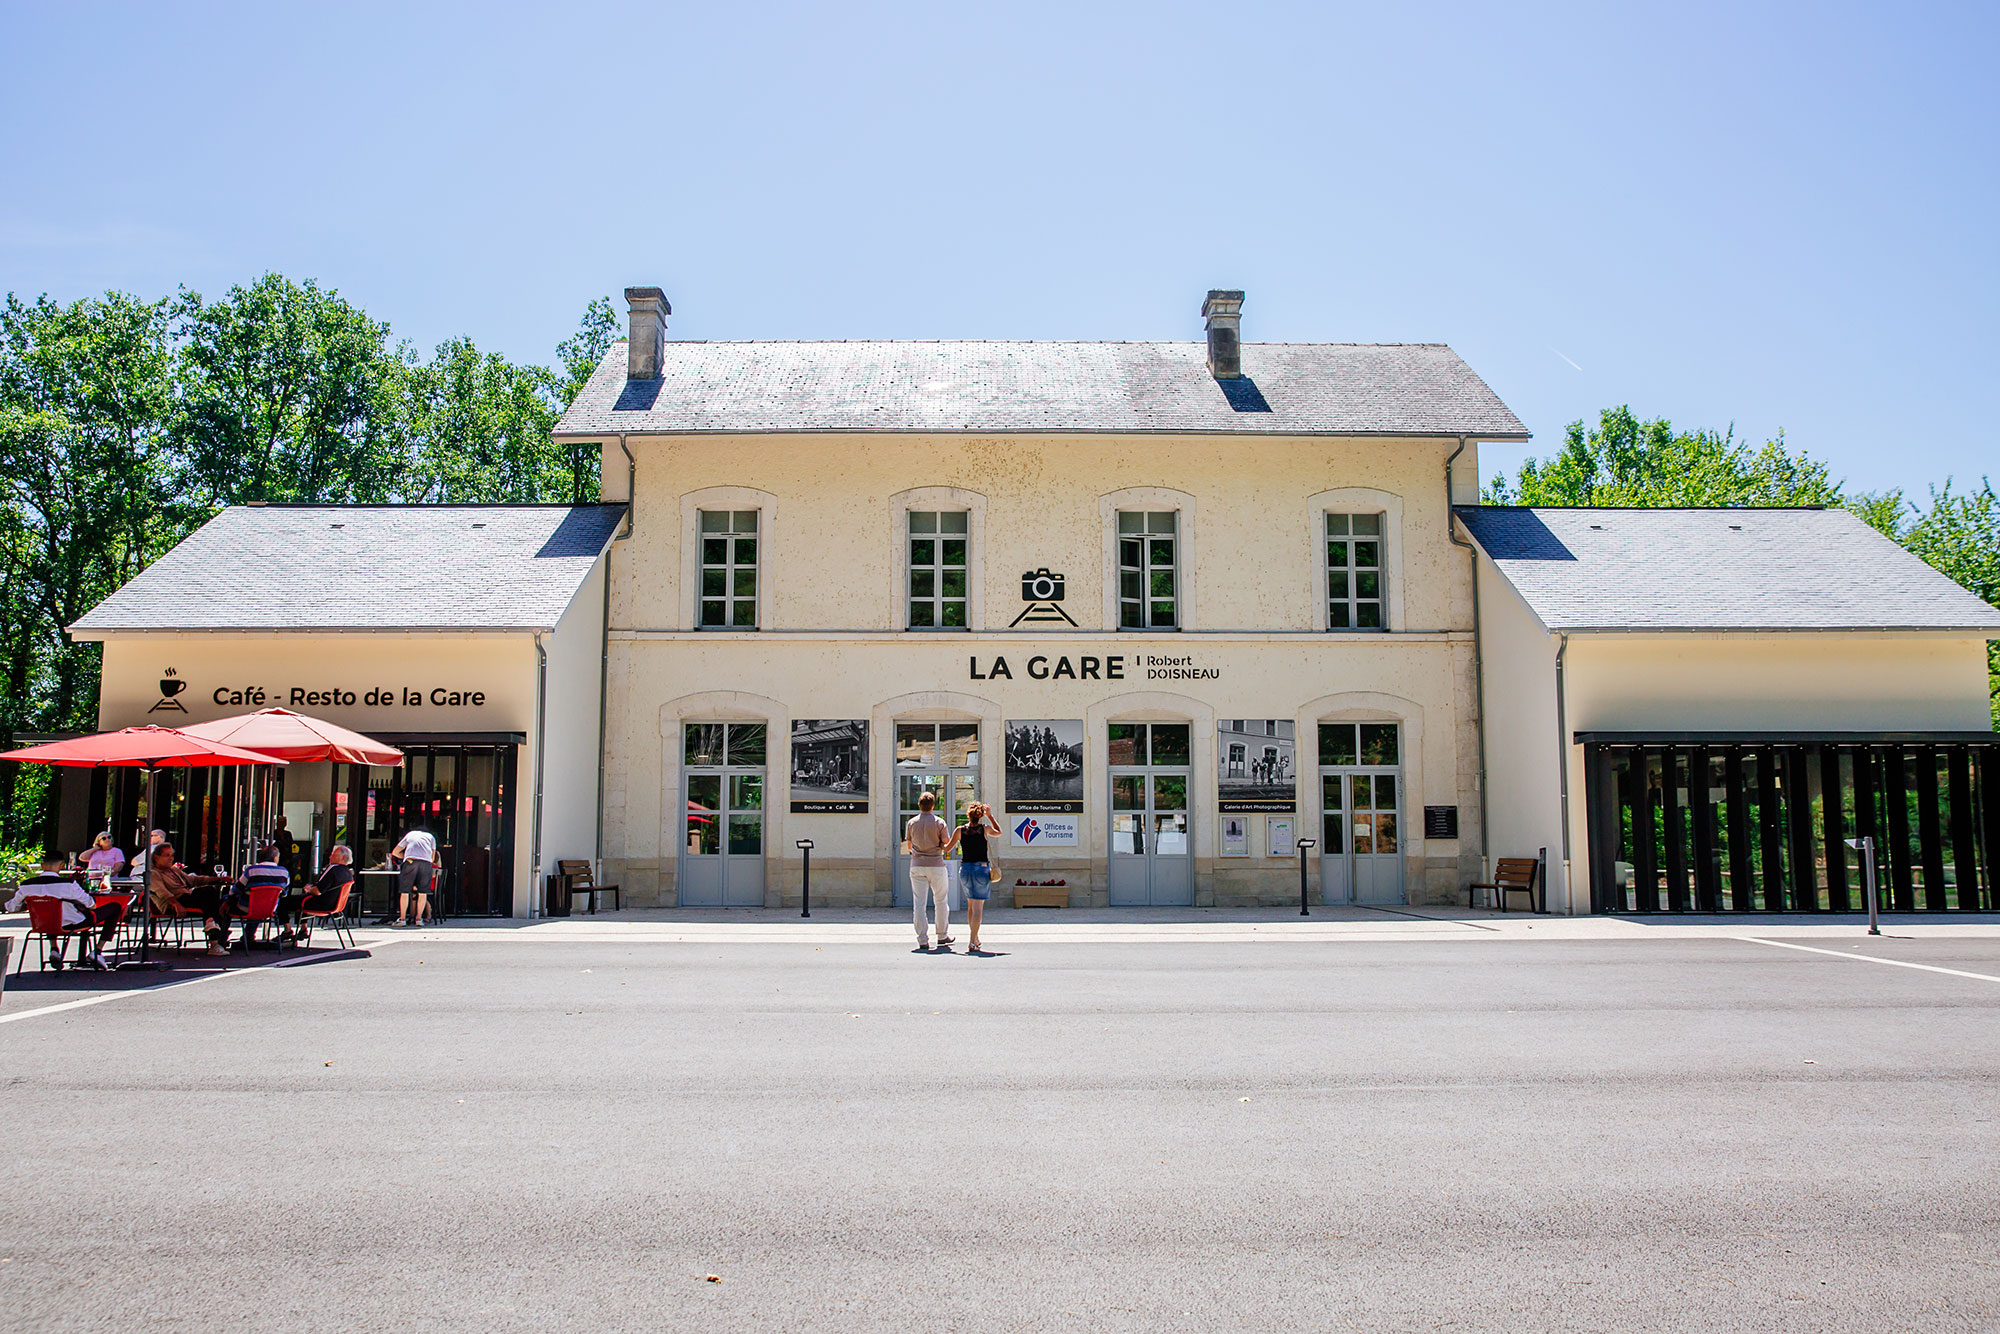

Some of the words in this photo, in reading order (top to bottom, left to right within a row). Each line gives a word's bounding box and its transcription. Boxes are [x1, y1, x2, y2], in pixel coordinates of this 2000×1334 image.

[1147, 655, 1192, 666] Robert
[970, 656, 1013, 680] LA
[1027, 655, 1125, 680] GARE
[1148, 668, 1220, 680] DOISNEAU
[213, 686, 266, 706] Café
[290, 687, 357, 706] Resto
[364, 687, 394, 706] de
[402, 687, 422, 706] la
[430, 687, 486, 706] Gare
[1044, 823, 1066, 831] Offices
[1045, 831, 1074, 839] Tourisme
